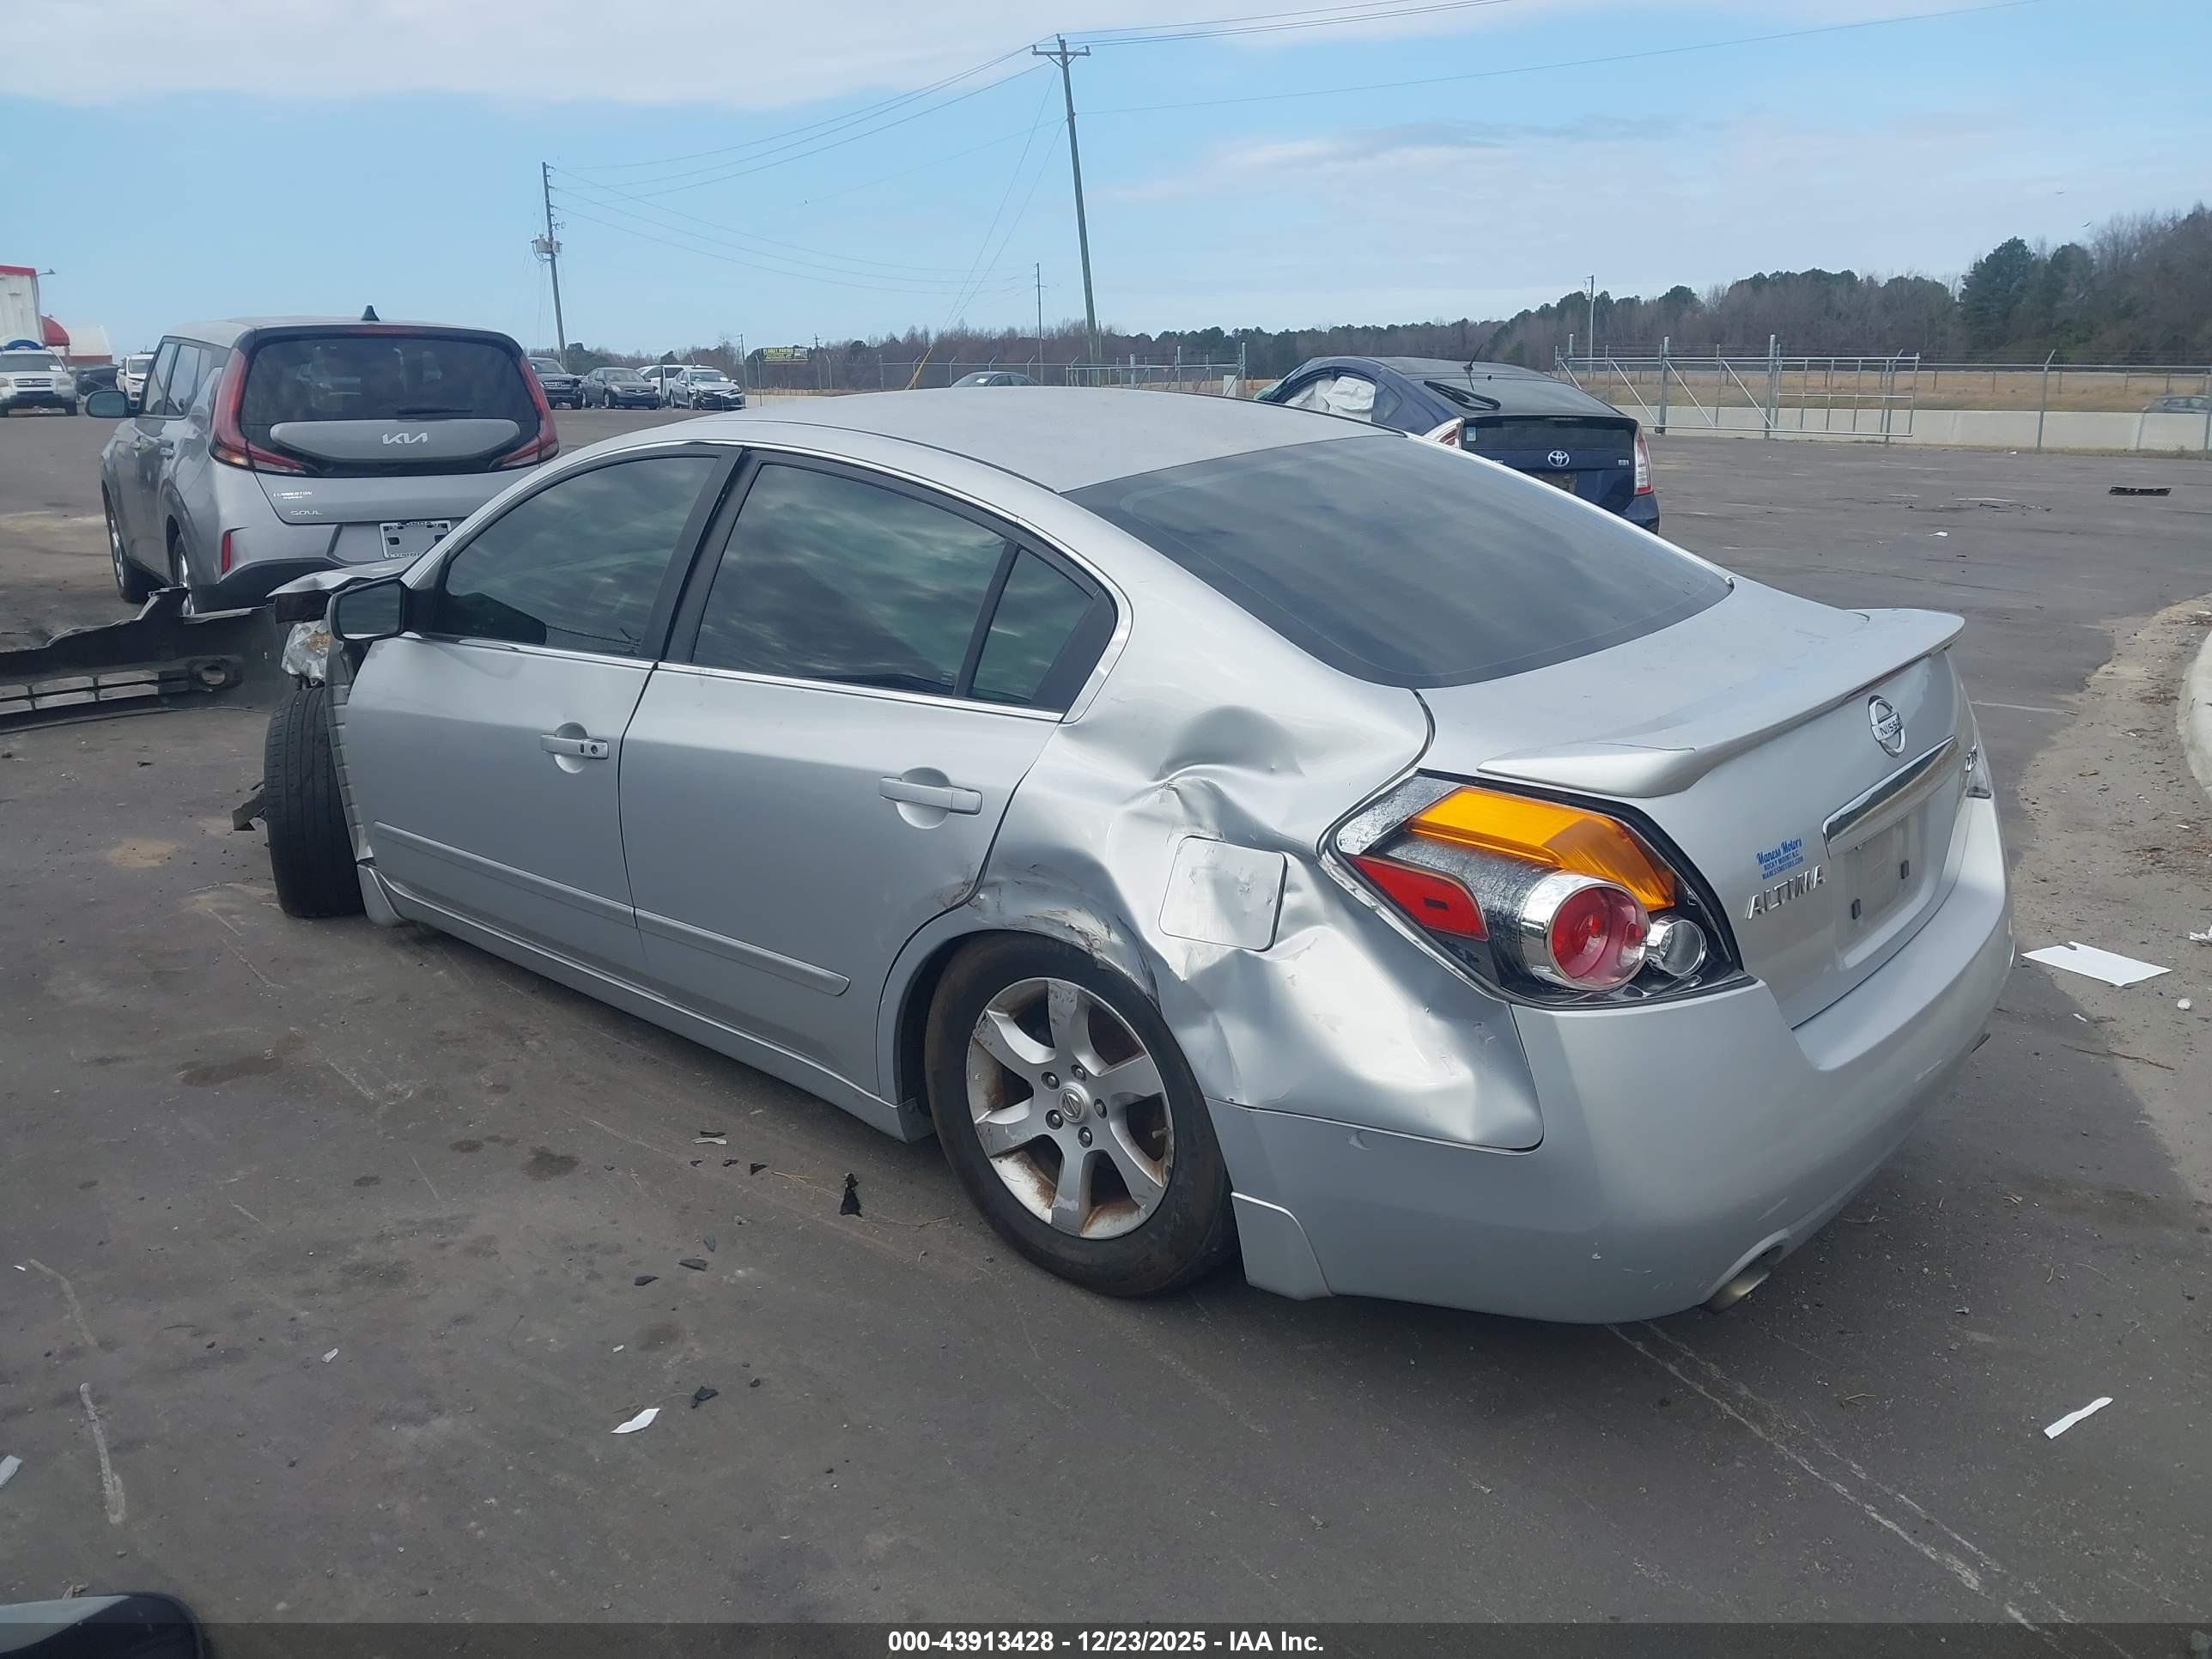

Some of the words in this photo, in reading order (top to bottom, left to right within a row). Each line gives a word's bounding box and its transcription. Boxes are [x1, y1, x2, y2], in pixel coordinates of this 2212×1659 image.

[382, 432, 428, 445] KIA
[1756, 848, 1781, 866] Maness
[1780, 838, 1802, 854] Motors
[1745, 864, 1826, 921] ALTIMA
